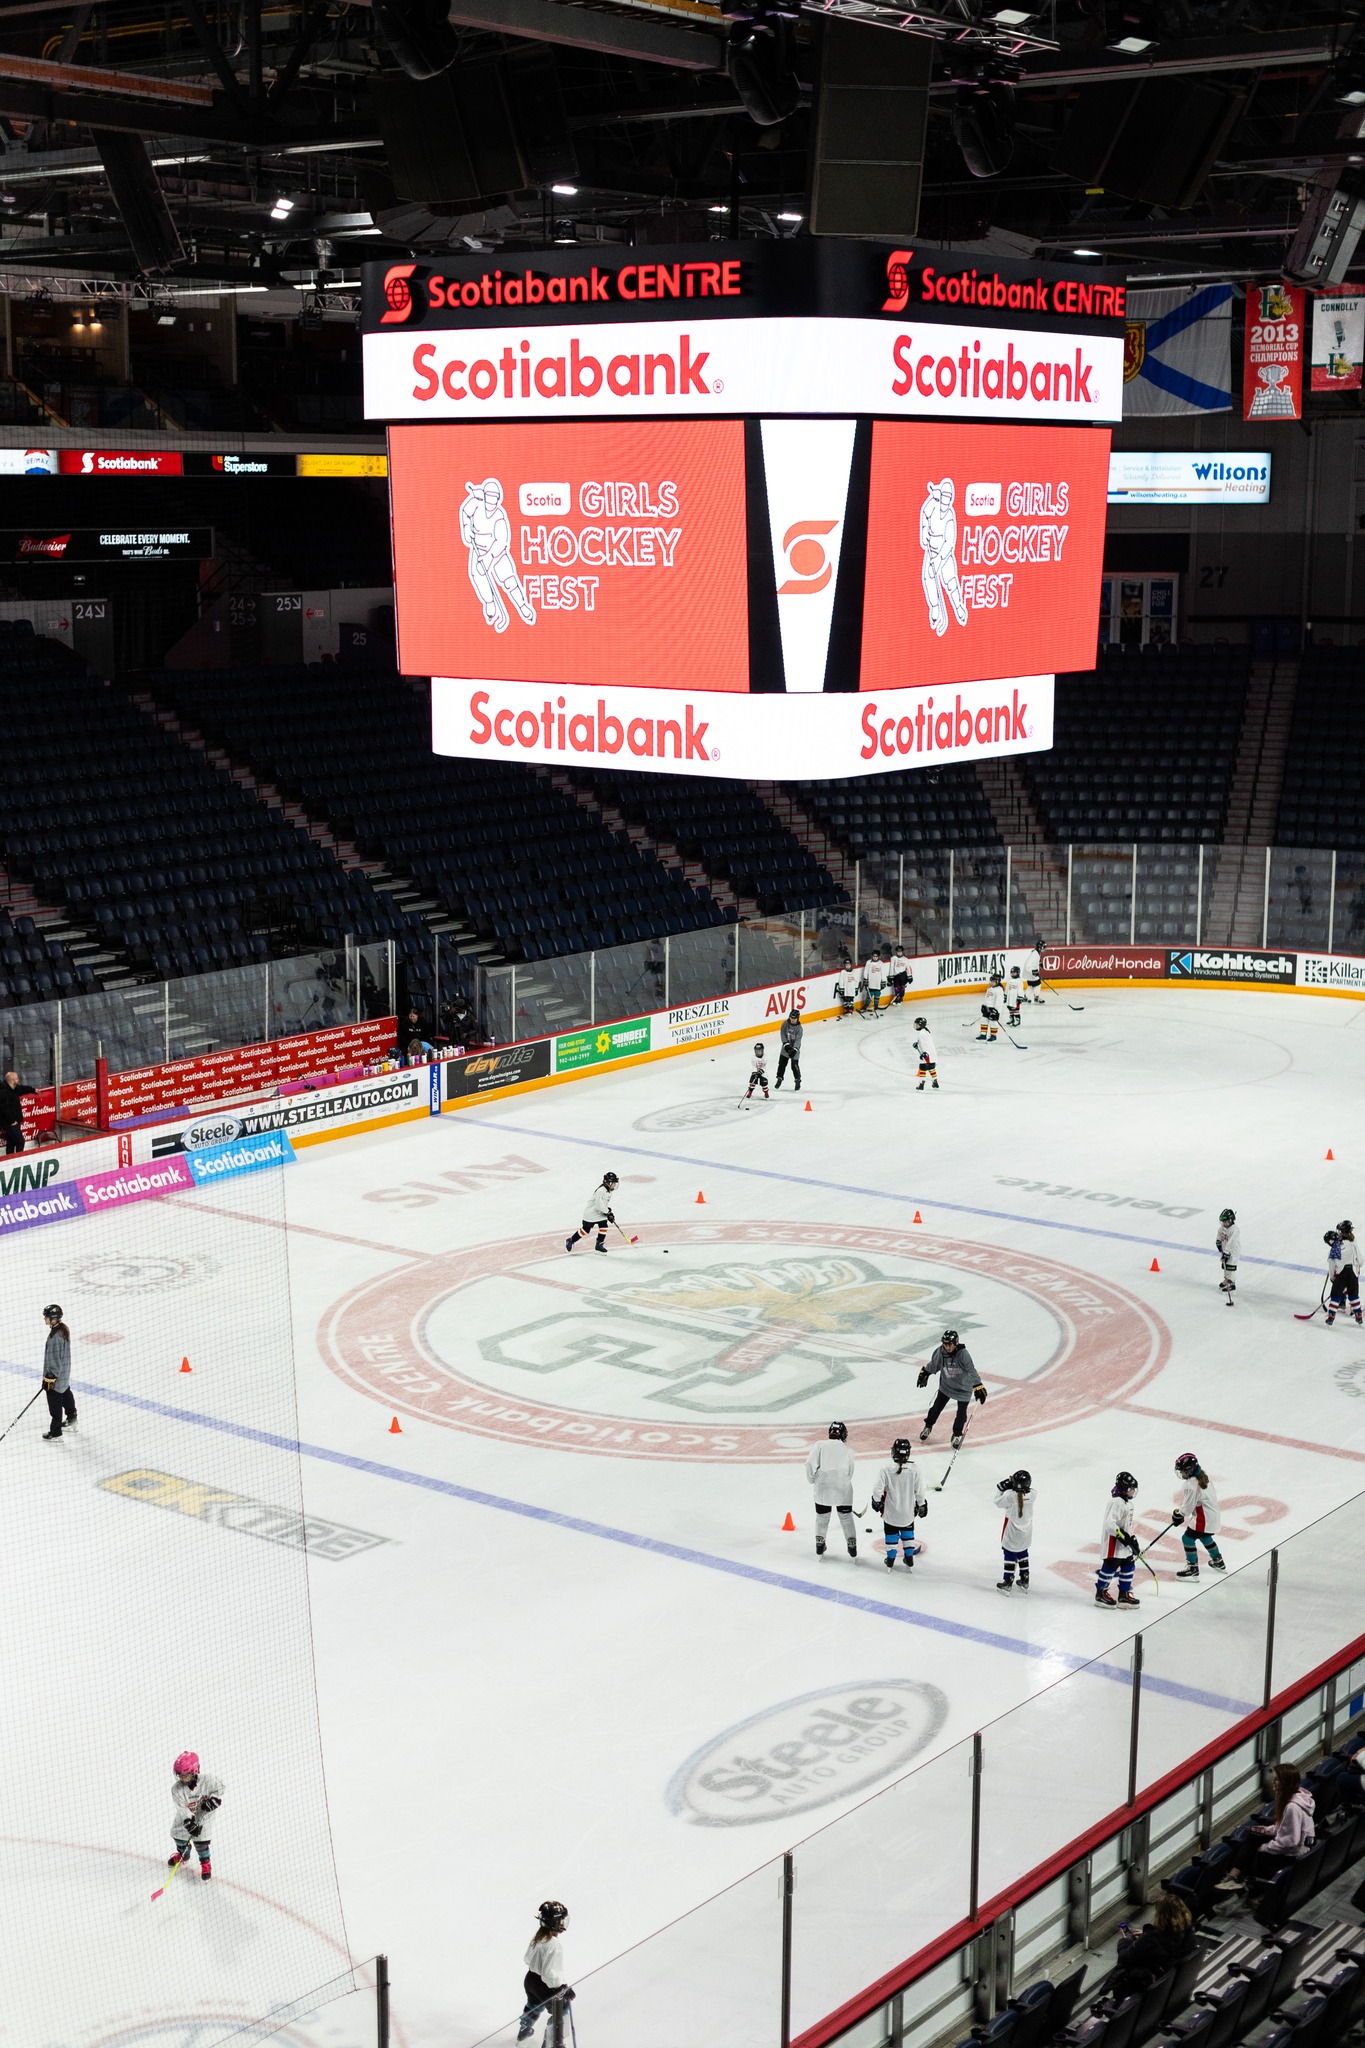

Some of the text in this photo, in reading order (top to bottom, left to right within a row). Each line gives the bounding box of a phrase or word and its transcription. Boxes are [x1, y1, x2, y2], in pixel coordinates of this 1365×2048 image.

[428, 260, 741, 309] Scotiabank CENTRE
[921, 267, 1126, 317] Scotiabank CENTRE
[1321, 302, 1359, 312] CONNOLLY
[1251, 323, 1299, 343] 2013
[1250, 342, 1299, 352] MEMORIAL CUP
[1250, 351, 1299, 363] CHAMPIONS
[412, 334, 711, 401] Scotiabank
[891, 335, 1093, 403] Scotiabank
[98, 455, 159, 470] Scotiabank
[224, 462, 268, 475] Superstore
[1193, 463, 1267, 481] Wilsons
[1006, 481, 1069, 517] GIRLS
[1130, 491, 1188, 499] wilsonsheating.ca
[1224, 482, 1266, 494] Heating
[526, 493, 562, 507] Scotia
[579, 481, 680, 518] GIRLS
[970, 493, 995, 507] Scotia
[19, 540, 67, 553] Budweiser
[99, 533, 190, 545] CELEBRATE EVERY MOMENT.
[520, 525, 682, 566] HOCKEY
[962, 525, 1069, 566] HOCKEY
[1200, 566, 1229, 588] 27
[522, 575, 600, 611] FEST
[960, 573, 1013, 609] FEST
[75, 604, 94, 620] 24
[277, 597, 293, 611] 25
[352, 632, 367, 646] 25
[470, 691, 710, 760] Scotiabank
[861, 689, 1028, 760] Scotiabank
[938, 953, 1006, 985] MONTANA'S
[1067, 955, 1162, 971] Colonial Honda
[1193, 952, 1293, 974] Kohltech
[1193, 968, 1281, 981] Windows & Entrance Systems
[1329, 976, 1361, 987] APARTMENT
[668, 1000, 730, 1025] PRESZLER
[765, 986, 807, 1018] AVIS
[612, 1028, 648, 1045] SUNBELT
[671, 1019, 725, 1038] INJURY LAWYERS
[676, 1027, 723, 1045] 1-800-JUSTICE
[120, 1071, 154, 1083] Scotiabank
[161, 1062, 195, 1075] Scotiabank
[201, 1054, 235, 1067] Scotiabank
[241, 1046, 273, 1059] Scotiabank
[279, 1038, 310, 1051] Scotiabank
[315, 1031, 346, 1043] Scotiabank
[351, 1023, 381, 1036] Scotiabank
[616, 1038, 643, 1049] RENTALS
[108, 1030, 398, 1097] tiabank Scotiabank Scotiabank Scotiabank Scotiabank Scotiabank Scotiabank Scotiabank
[464, 1047, 535, 1077] daynite
[76, 1081, 97, 1093] Scotia
[120, 1093, 155, 1107] Scotiabank
[162, 1085, 195, 1098] Scotiabank
[202, 1077, 235, 1090] Scotiabank
[241, 1069, 273, 1082] Scotiabank
[279, 1061, 310, 1074] Scotiabank
[315, 1053, 346, 1065] Scotiabank
[351, 1045, 381, 1058] Scotiabank
[60, 1095, 91, 1109] cotiabank
[142, 1101, 175, 1114] Scotiabank
[183, 1093, 216, 1106] Scotiabank
[222, 1085, 254, 1098] Scotiabank
[260, 1076, 292, 1089] Scotiabank
[31, 1105, 56, 1117] Hortons
[77, 1106, 97, 1117] Scotia
[245, 1083, 415, 1133] WWW.STEELEAUTO.COM
[190, 1122, 235, 1145] Steele
[193, 1136, 231, 1151] AUTO GROUP
[194, 1141, 284, 1182] Scotiabank
[84, 1170, 184, 1205] Scotiabank
[362, 1154, 550, 1209] AVIS
[743, 1224, 1116, 1319] Scotiabank CENTRE
[356, 1332, 740, 1453] Scotiabank CENTRE
[97, 1467, 258, 1523] OK
[698, 1696, 905, 1804] Steele
[770, 1718, 911, 1806] AUTO GROUP
